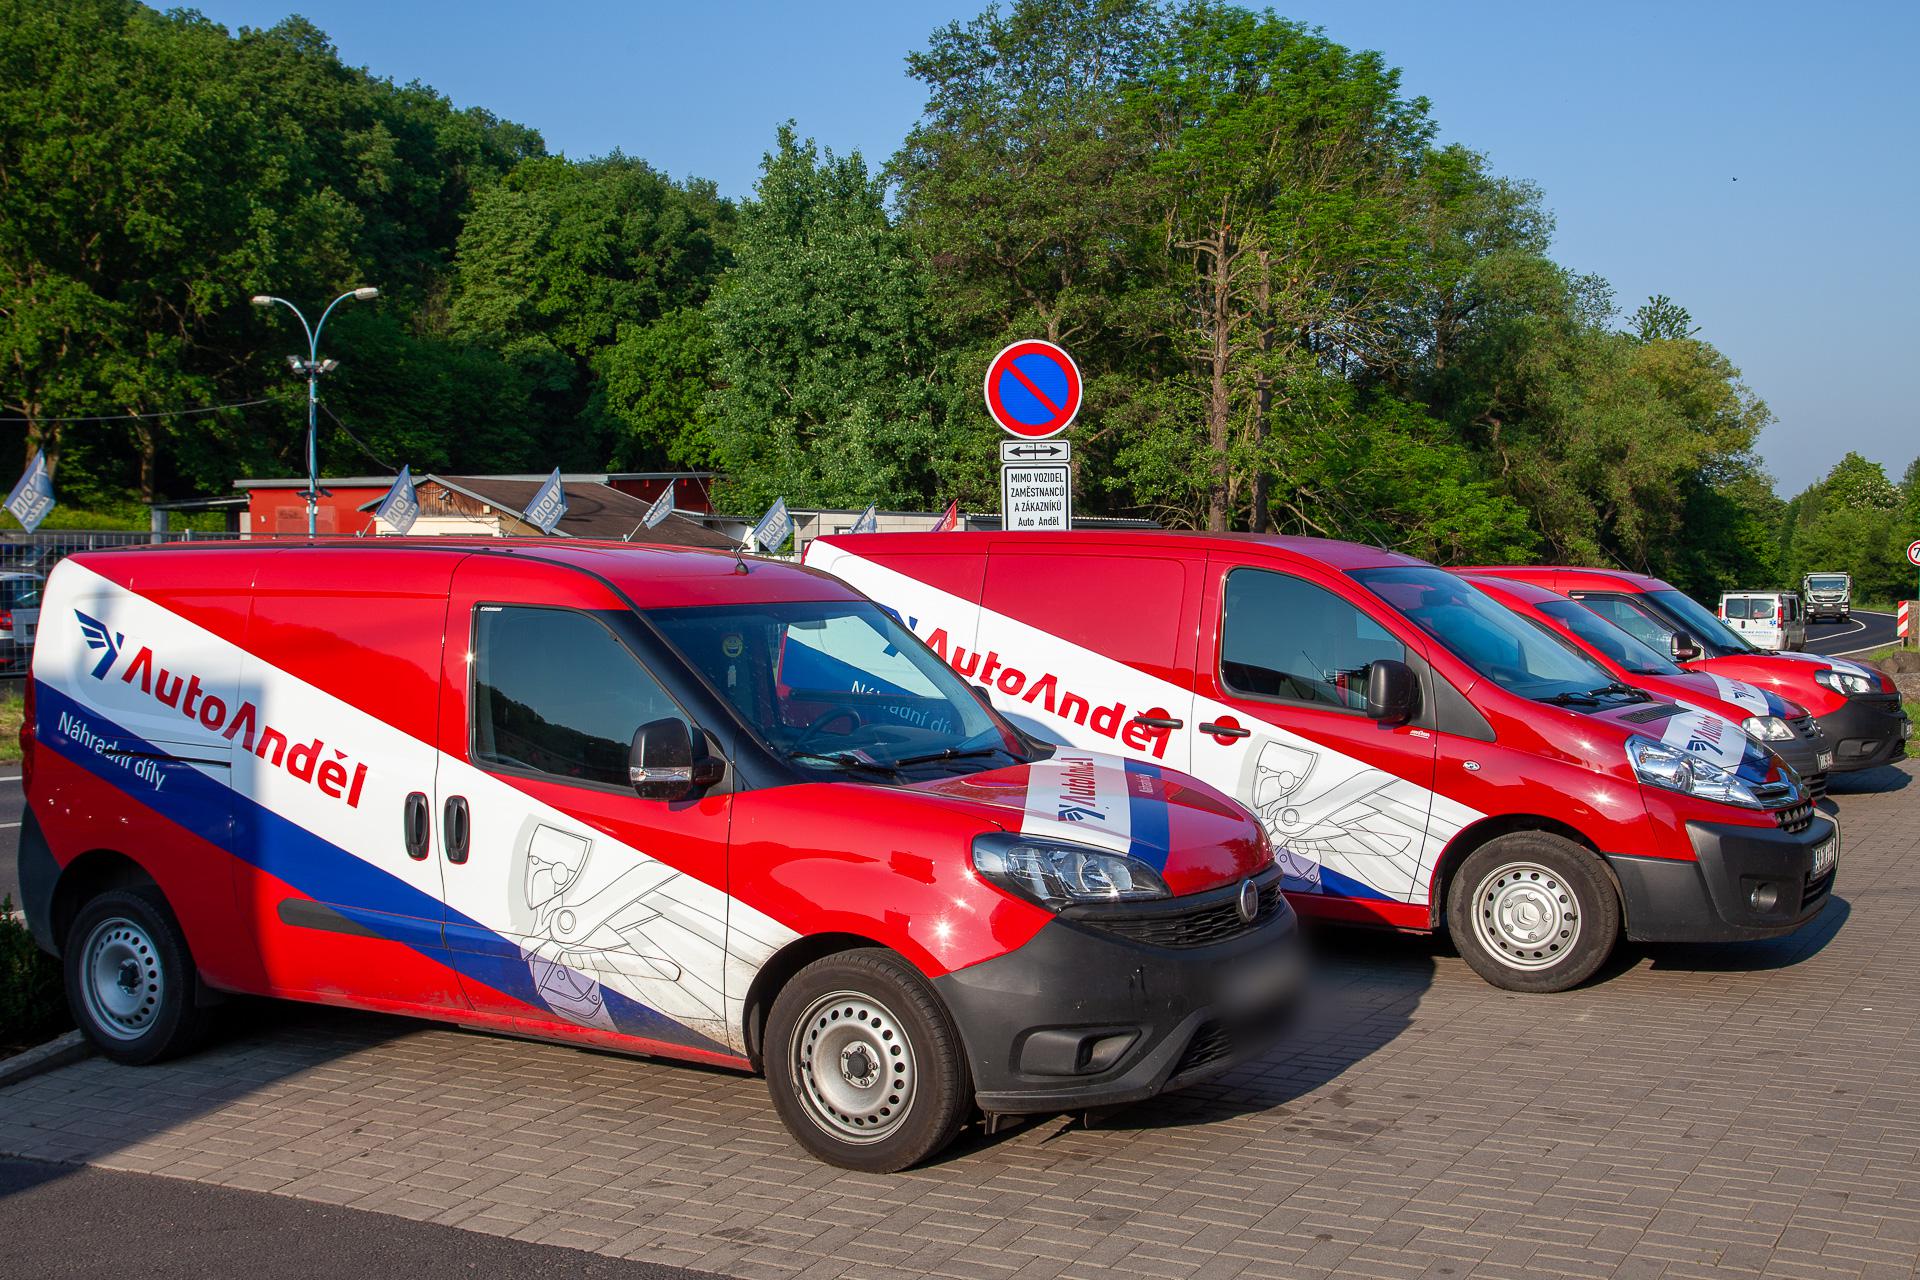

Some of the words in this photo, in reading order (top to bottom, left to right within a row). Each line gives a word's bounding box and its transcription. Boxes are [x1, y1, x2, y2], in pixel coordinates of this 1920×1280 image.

[1011, 473, 1032, 483] MIMO
[1033, 472, 1064, 483] VOZIDEL
[1010, 485, 1065, 498] ZAMĚSTNANCŮ
[1014, 502, 1020, 512] A
[1021, 500, 1062, 512] ZÁKAZNÍKŮ
[1018, 517, 1035, 527] Auto
[1038, 516, 1060, 526] Anděl
[1913, 547, 1920, 558] 7
[121, 645, 369, 809] AutoAnděl
[134, 758, 166, 791] díly
